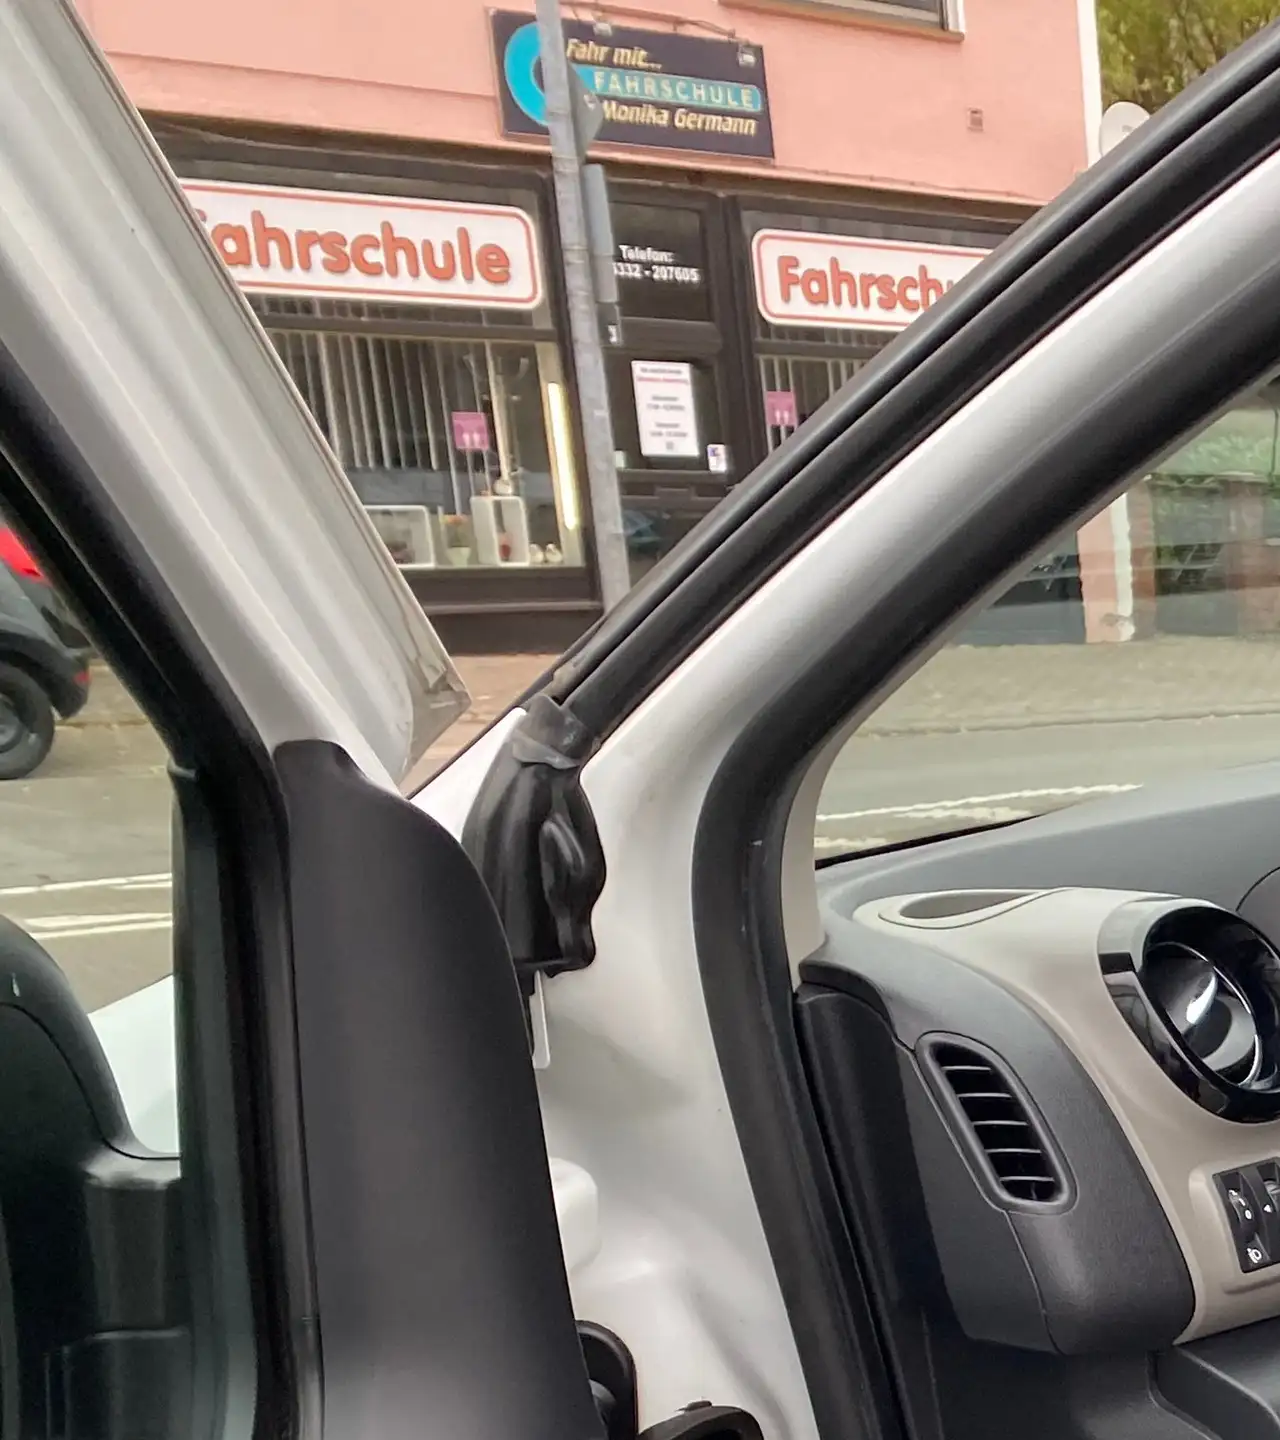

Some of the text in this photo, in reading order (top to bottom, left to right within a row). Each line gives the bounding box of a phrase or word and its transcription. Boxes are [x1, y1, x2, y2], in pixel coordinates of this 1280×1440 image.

[566, 38, 608, 63] Fahr
[594, 70, 754, 106] FAHRSCHULE
[602, 100, 757, 137] Monika Germann
[195, 208, 512, 285] ahrschule
[618, 244, 675, 263] Telefon:
[777, 254, 953, 313] Fahrsch
